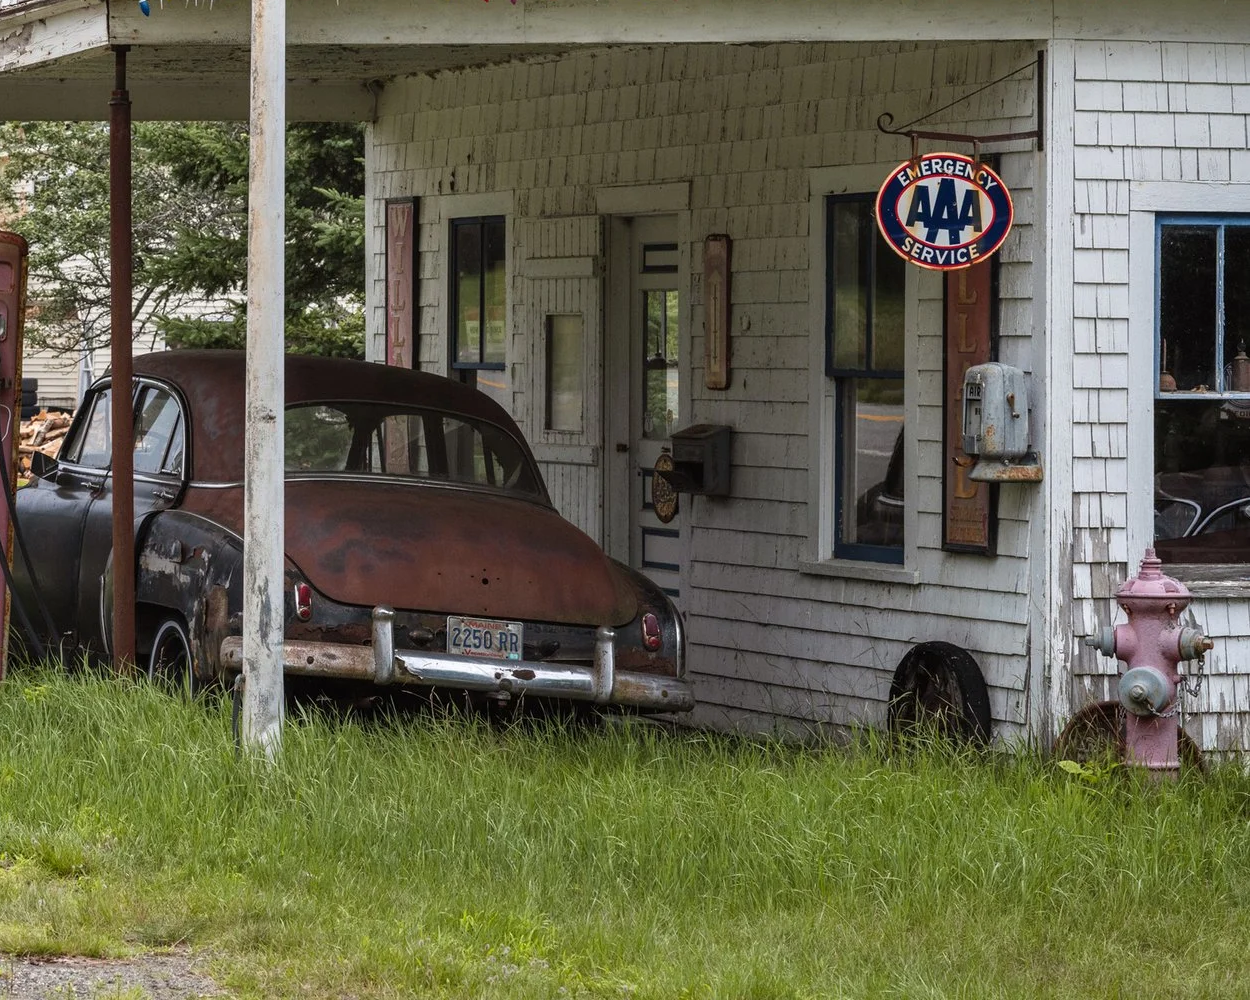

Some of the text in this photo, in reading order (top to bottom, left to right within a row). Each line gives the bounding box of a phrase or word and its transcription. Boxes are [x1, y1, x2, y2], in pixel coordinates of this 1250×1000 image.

[897, 158, 997, 190] EMERGENCY
[905, 178, 982, 245] AAA
[902, 237, 979, 264] SERVICE
[969, 386, 981, 397] AIR
[469, 621, 503, 630] MAINE
[452, 627, 519, 653] 2250 RR
